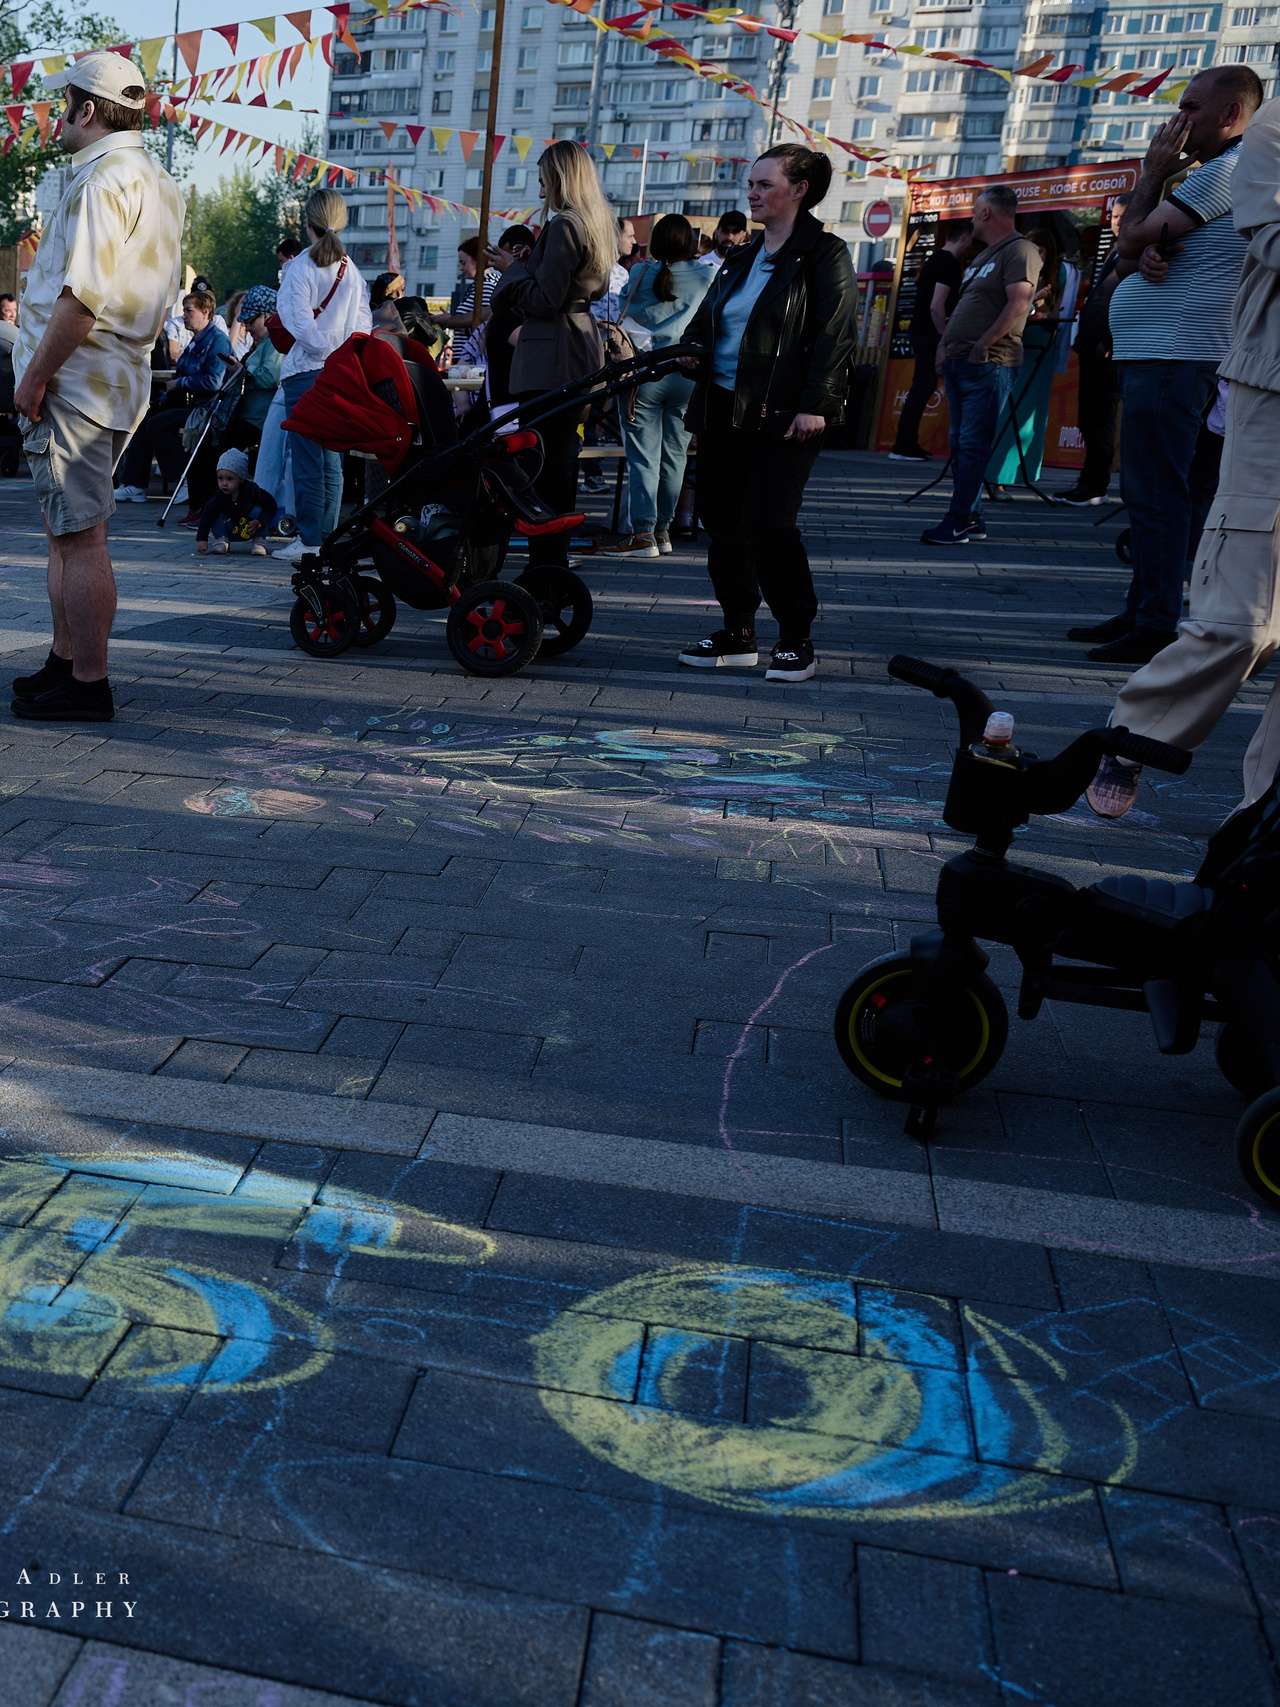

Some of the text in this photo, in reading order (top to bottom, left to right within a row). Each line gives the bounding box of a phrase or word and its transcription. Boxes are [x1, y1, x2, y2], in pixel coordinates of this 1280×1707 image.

[1013, 186, 1041, 199] OUSE
[1050, 182, 1078, 195] КОФЕ
[1080, 181, 1087, 192] С
[1089, 174, 1127, 191] СОБОЙ
